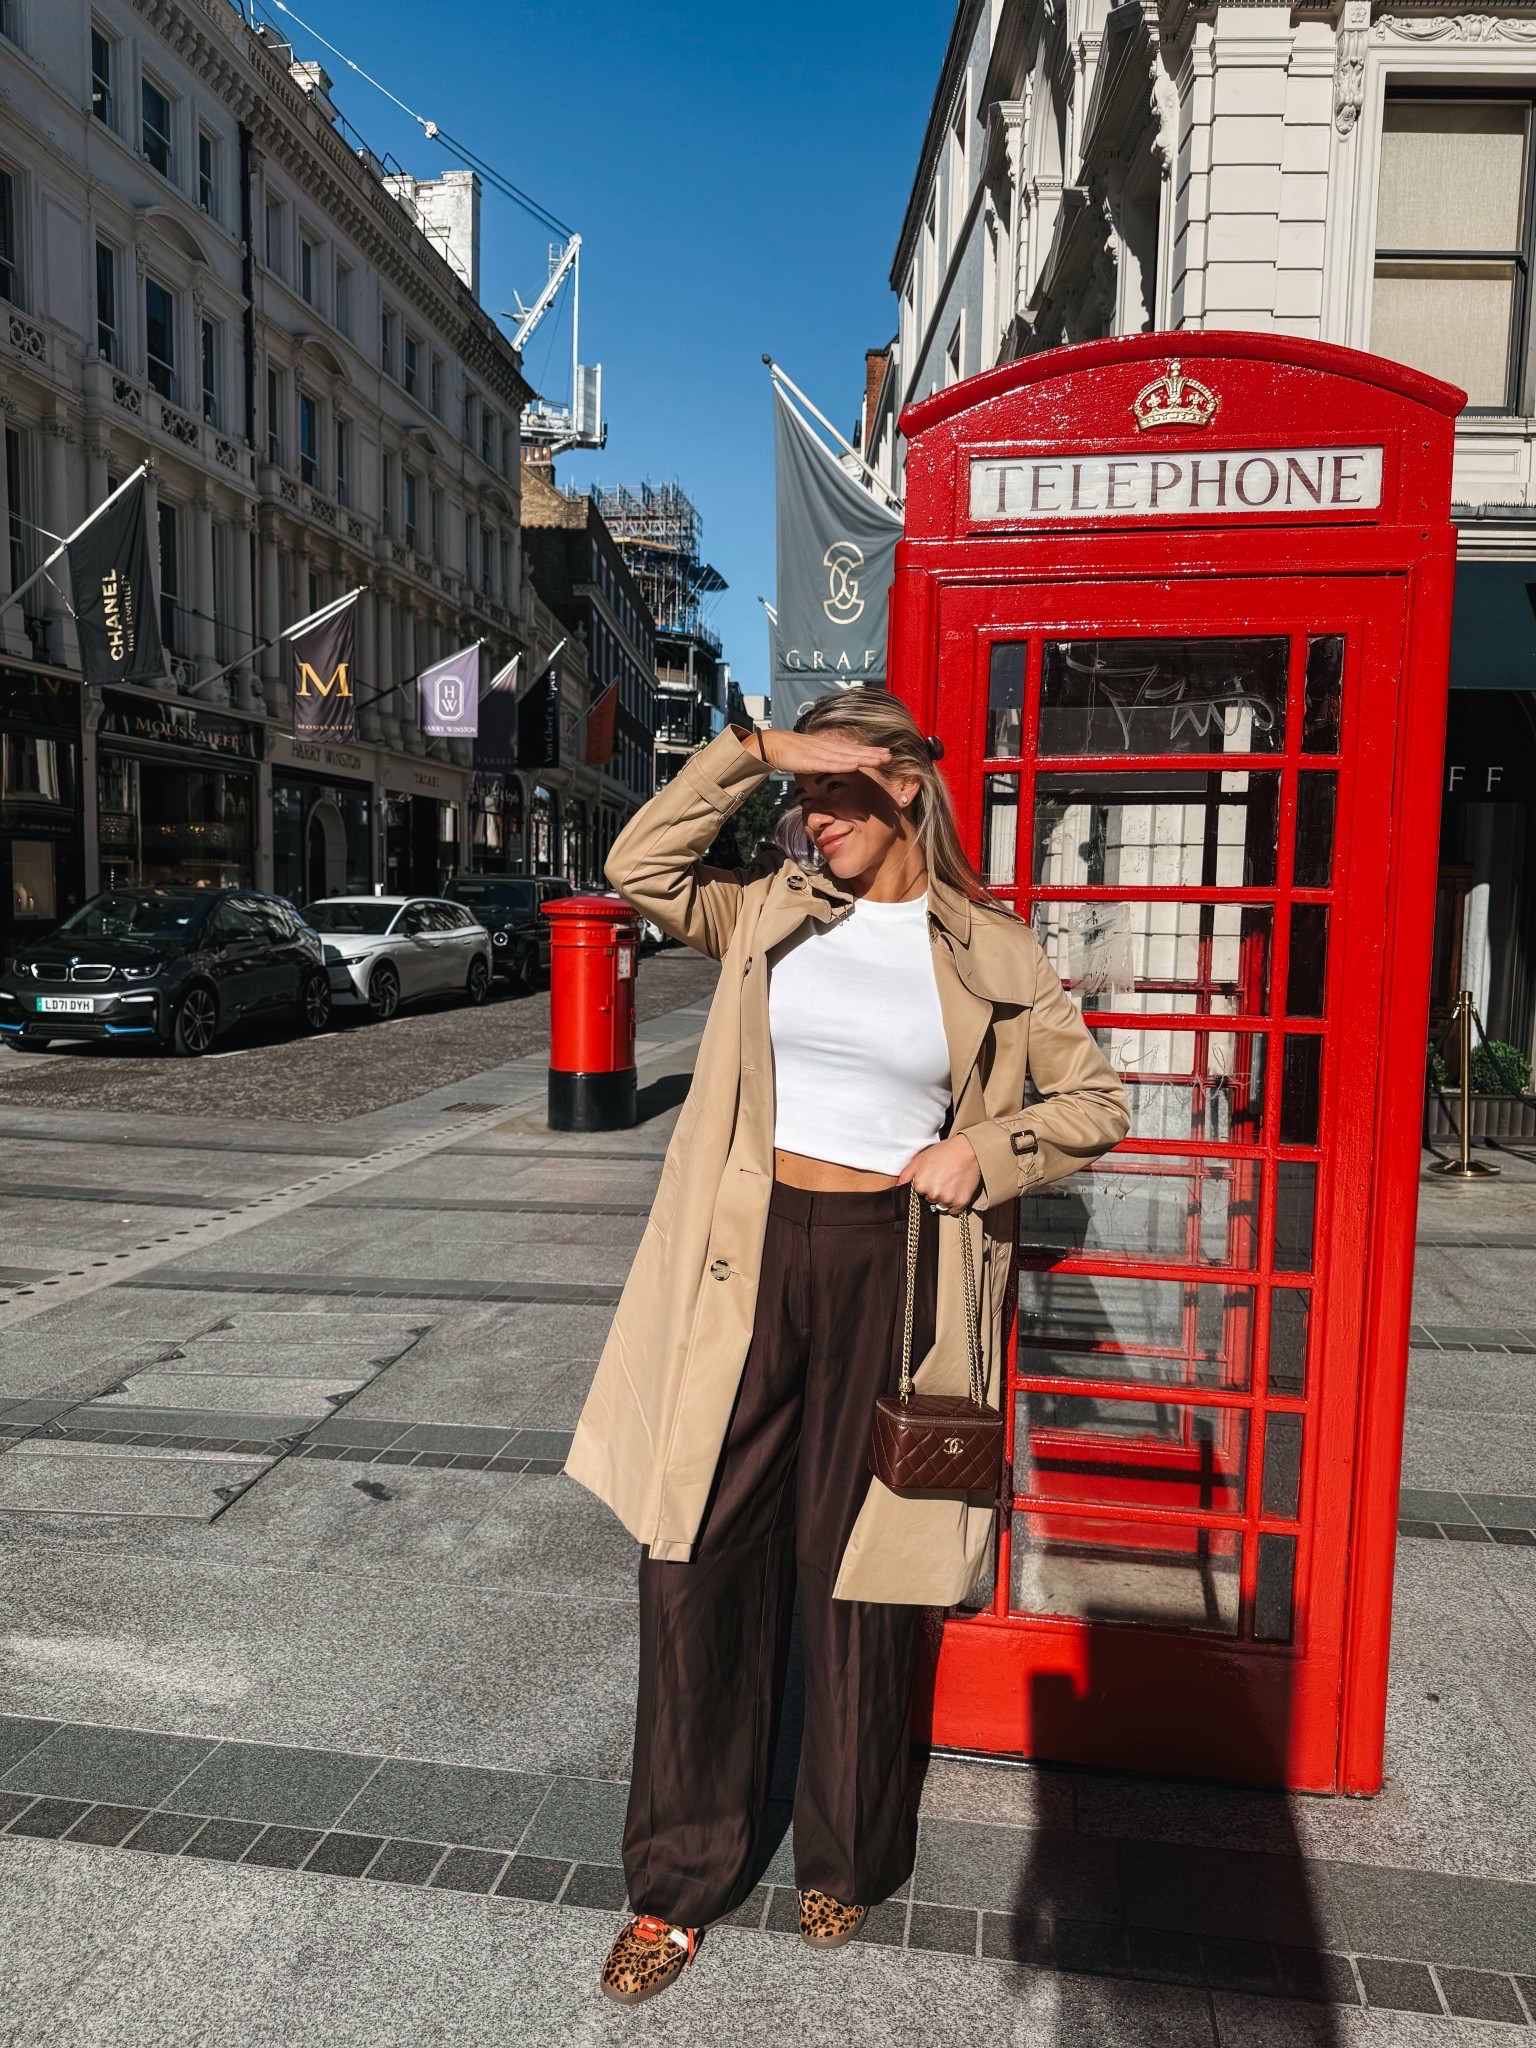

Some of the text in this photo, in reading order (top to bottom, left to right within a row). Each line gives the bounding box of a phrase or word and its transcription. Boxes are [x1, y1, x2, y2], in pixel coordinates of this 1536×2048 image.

[985, 454, 1365, 513] TELEPHONE
[102, 568, 124, 661] CHANEL
[296, 662, 353, 697] M
[446, 725, 477, 733] WINSTON
[292, 740, 320, 762] HARRY
[45, 999, 90, 1011] LD71 DYH
